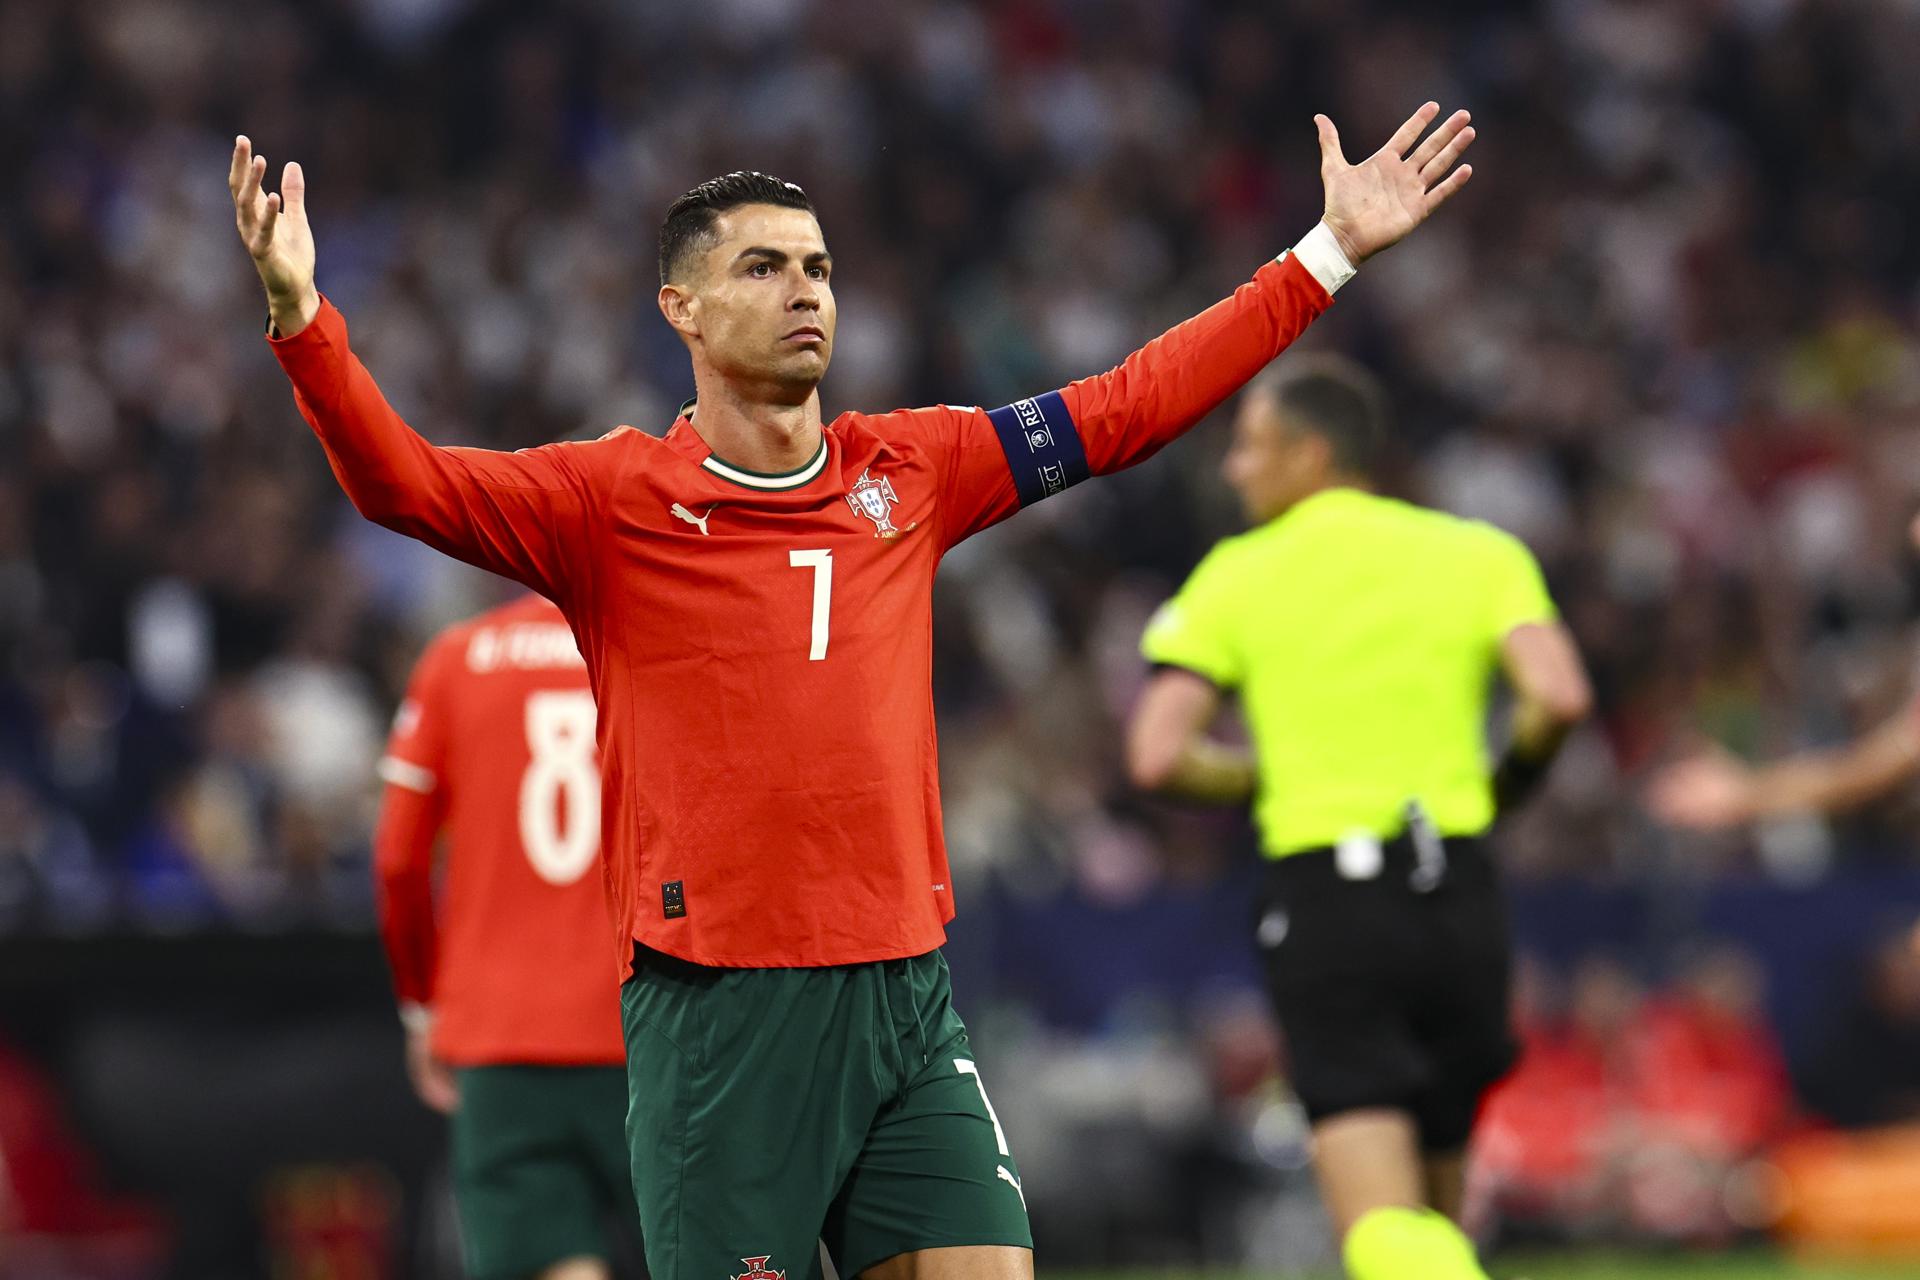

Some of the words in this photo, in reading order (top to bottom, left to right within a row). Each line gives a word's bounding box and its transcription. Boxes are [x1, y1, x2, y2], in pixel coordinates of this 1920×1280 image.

[789, 549, 833, 661] 7
[519, 690, 601, 885] 8
[953, 1058, 1010, 1156] 7
